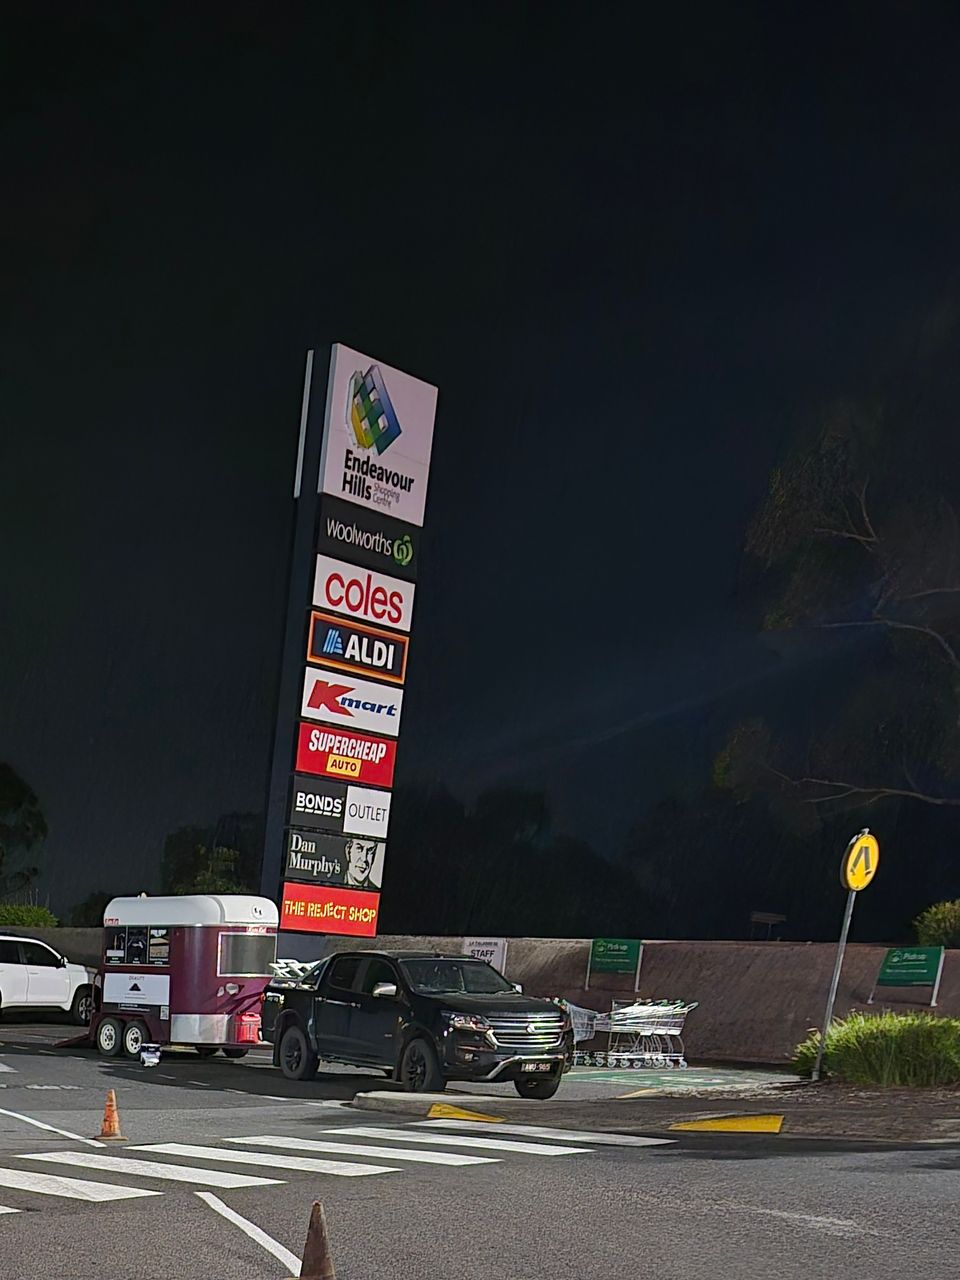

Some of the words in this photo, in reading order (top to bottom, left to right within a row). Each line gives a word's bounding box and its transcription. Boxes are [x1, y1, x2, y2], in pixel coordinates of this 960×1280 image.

[342, 471, 372, 500] Hills
[344, 449, 415, 492] Endeavour
[373, 483, 401, 503] Shopping
[326, 517, 392, 556] Woolworths
[325, 572, 403, 624] coles
[344, 634, 395, 670] ALDI
[307, 679, 397, 717] Kmart
[309, 729, 387, 764] SUPERCHEAP
[331, 759, 357, 772] AUTO
[296, 791, 343, 814] BONDS
[348, 803, 387, 822] OUTLET
[291, 834, 316, 853] Dan
[289, 852, 341, 878] Murphy's
[284, 900, 305, 916] THE
[307, 902, 347, 920] REJECT
[349, 906, 377, 923] SHOP
[471, 949, 495, 958] STAFF
